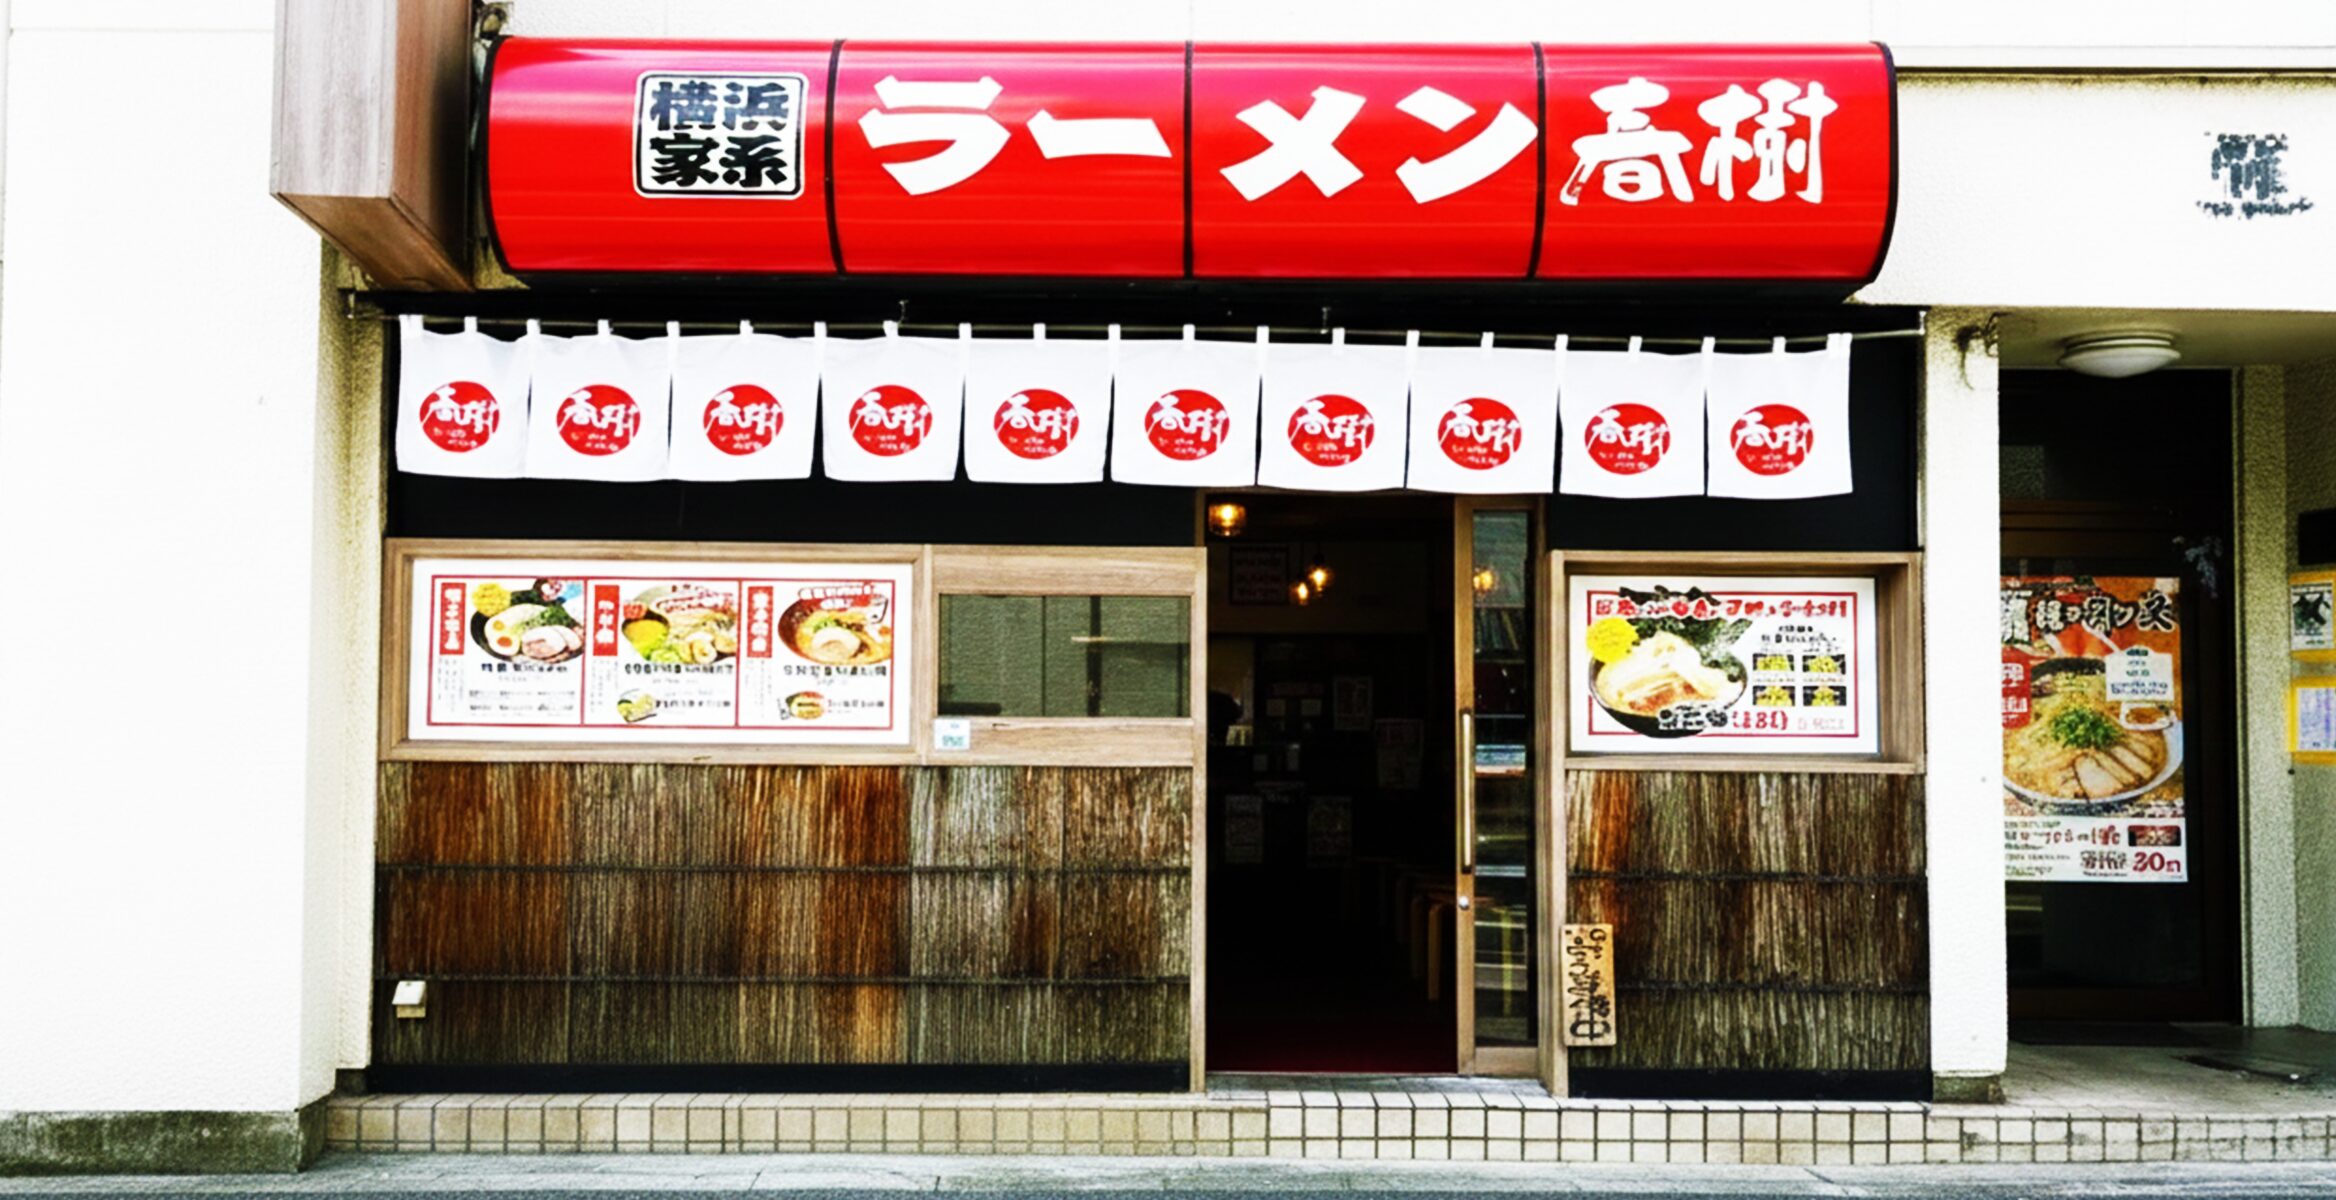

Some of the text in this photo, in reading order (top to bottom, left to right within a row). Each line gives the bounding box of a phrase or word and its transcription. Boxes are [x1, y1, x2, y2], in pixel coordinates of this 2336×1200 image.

[650, 81, 789, 131] 横浜
[858, 75, 1538, 204] ラーメン
[1560, 77, 1839, 205] 春樹
[650, 136, 788, 188] 家系
